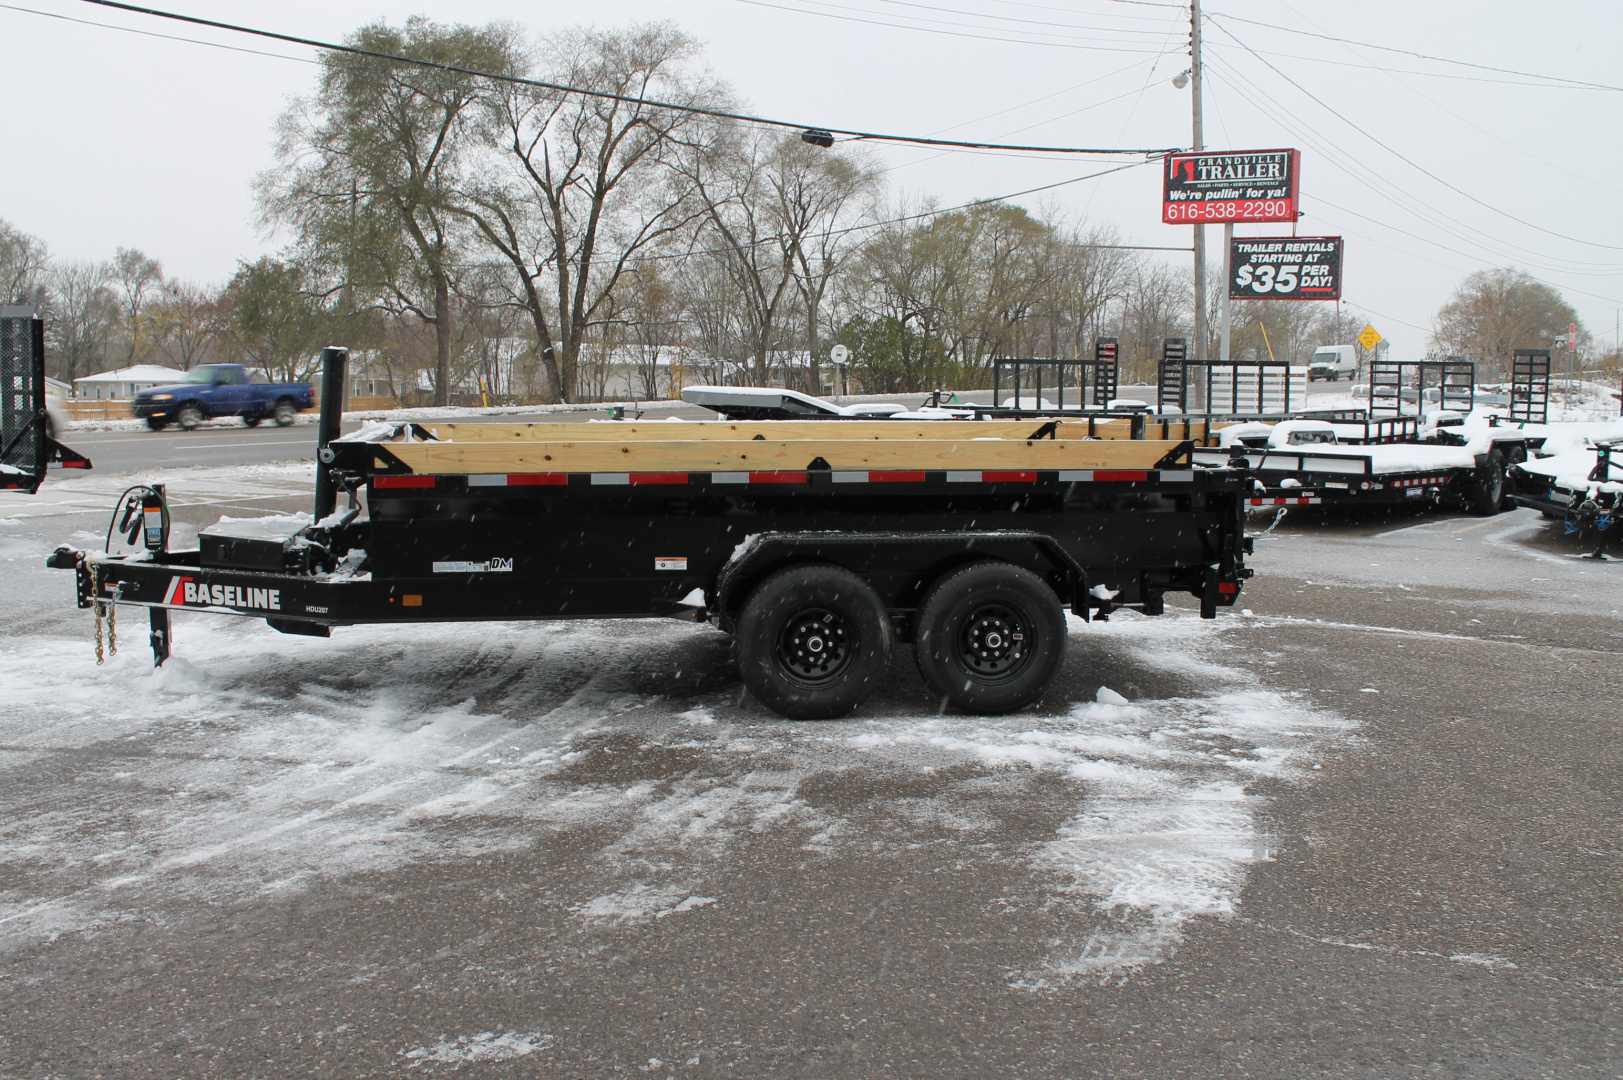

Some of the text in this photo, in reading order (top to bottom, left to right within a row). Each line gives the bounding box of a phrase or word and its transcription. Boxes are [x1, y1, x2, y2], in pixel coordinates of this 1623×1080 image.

[1199, 155, 1281, 166] GRANDVILLE
[1198, 164, 1280, 180] TRAILER
[1169, 186, 1287, 201] We're pullin' for ya!
[1168, 201, 1286, 219] 616-538-2290
[1238, 242, 1334, 252] TRAILER RENTALS
[1250, 254, 1320, 263] STARTING AT
[1301, 265, 1330, 276] PER
[1235, 263, 1300, 293] $35
[1300, 276, 1333, 287] DAY!
[492, 558, 512, 570] DM
[184, 581, 281, 611] BASELINE
[305, 605, 329, 614] HDU207
